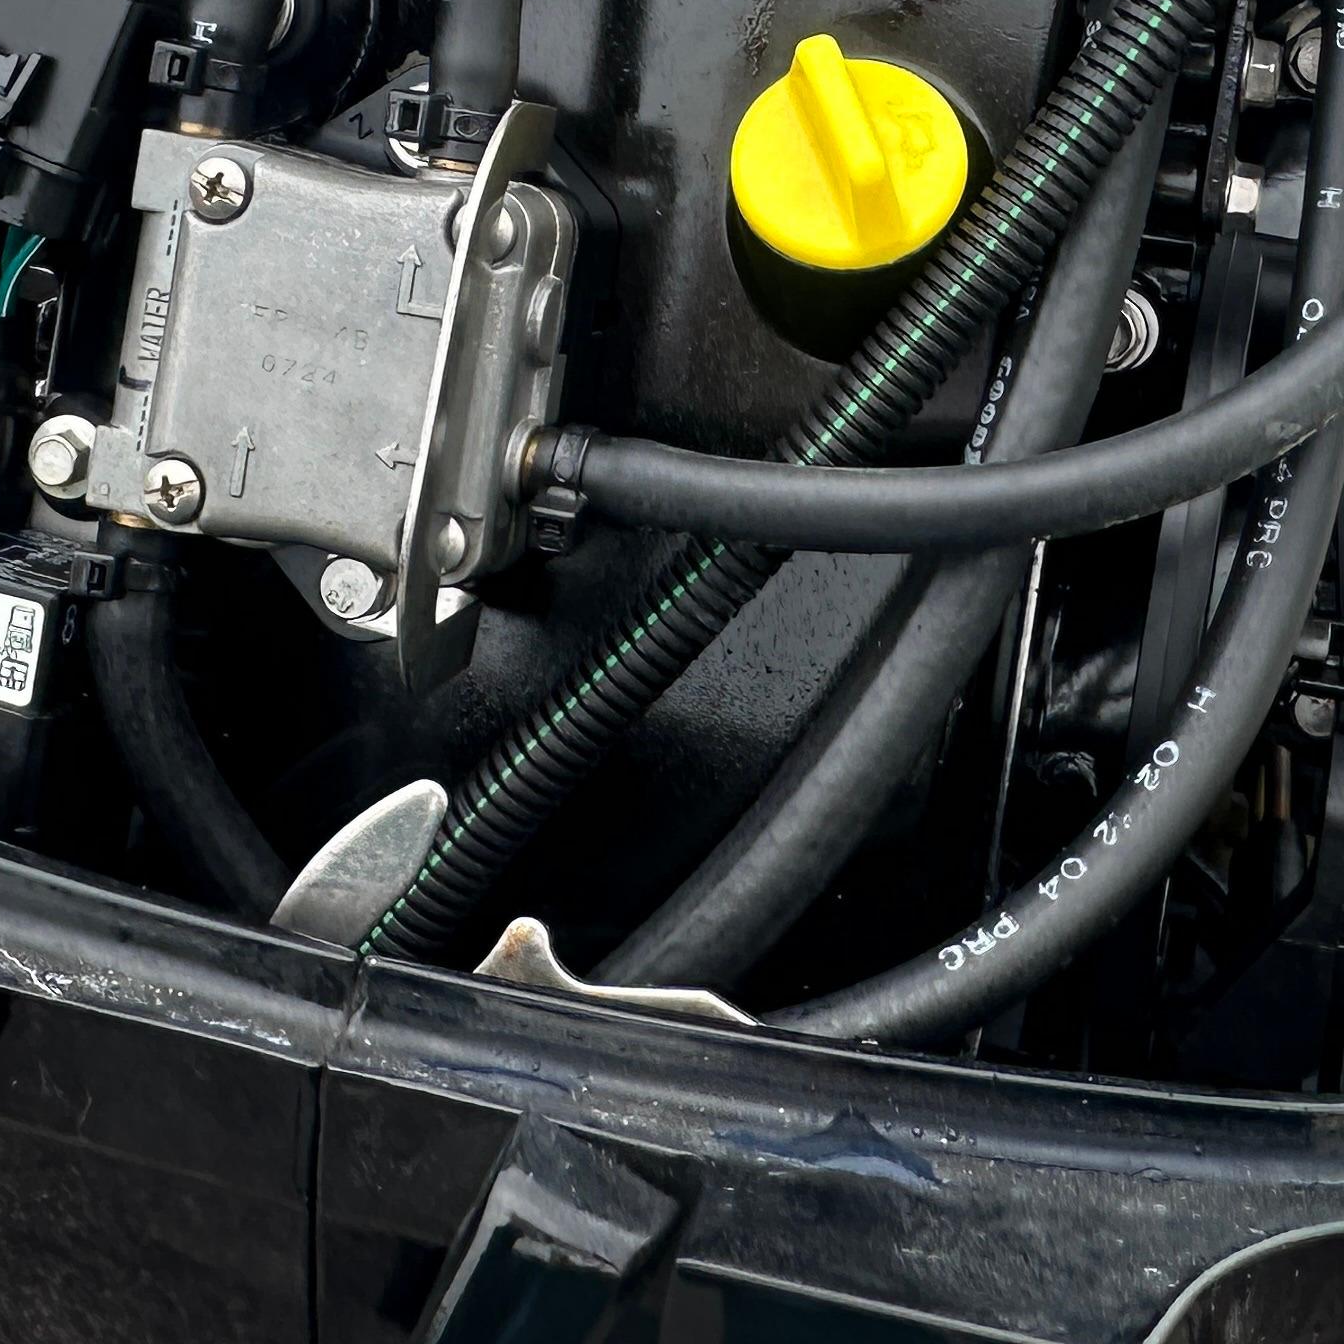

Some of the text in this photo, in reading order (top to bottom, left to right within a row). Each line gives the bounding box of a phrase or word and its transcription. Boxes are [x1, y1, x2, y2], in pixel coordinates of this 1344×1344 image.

[1316, 187, 1344, 209] H
[1296, 297, 1324, 341] 0
[1135, 740, 1180, 791] 02
[1039, 857, 1088, 901] 04
[938, 911, 1020, 971] PRC
